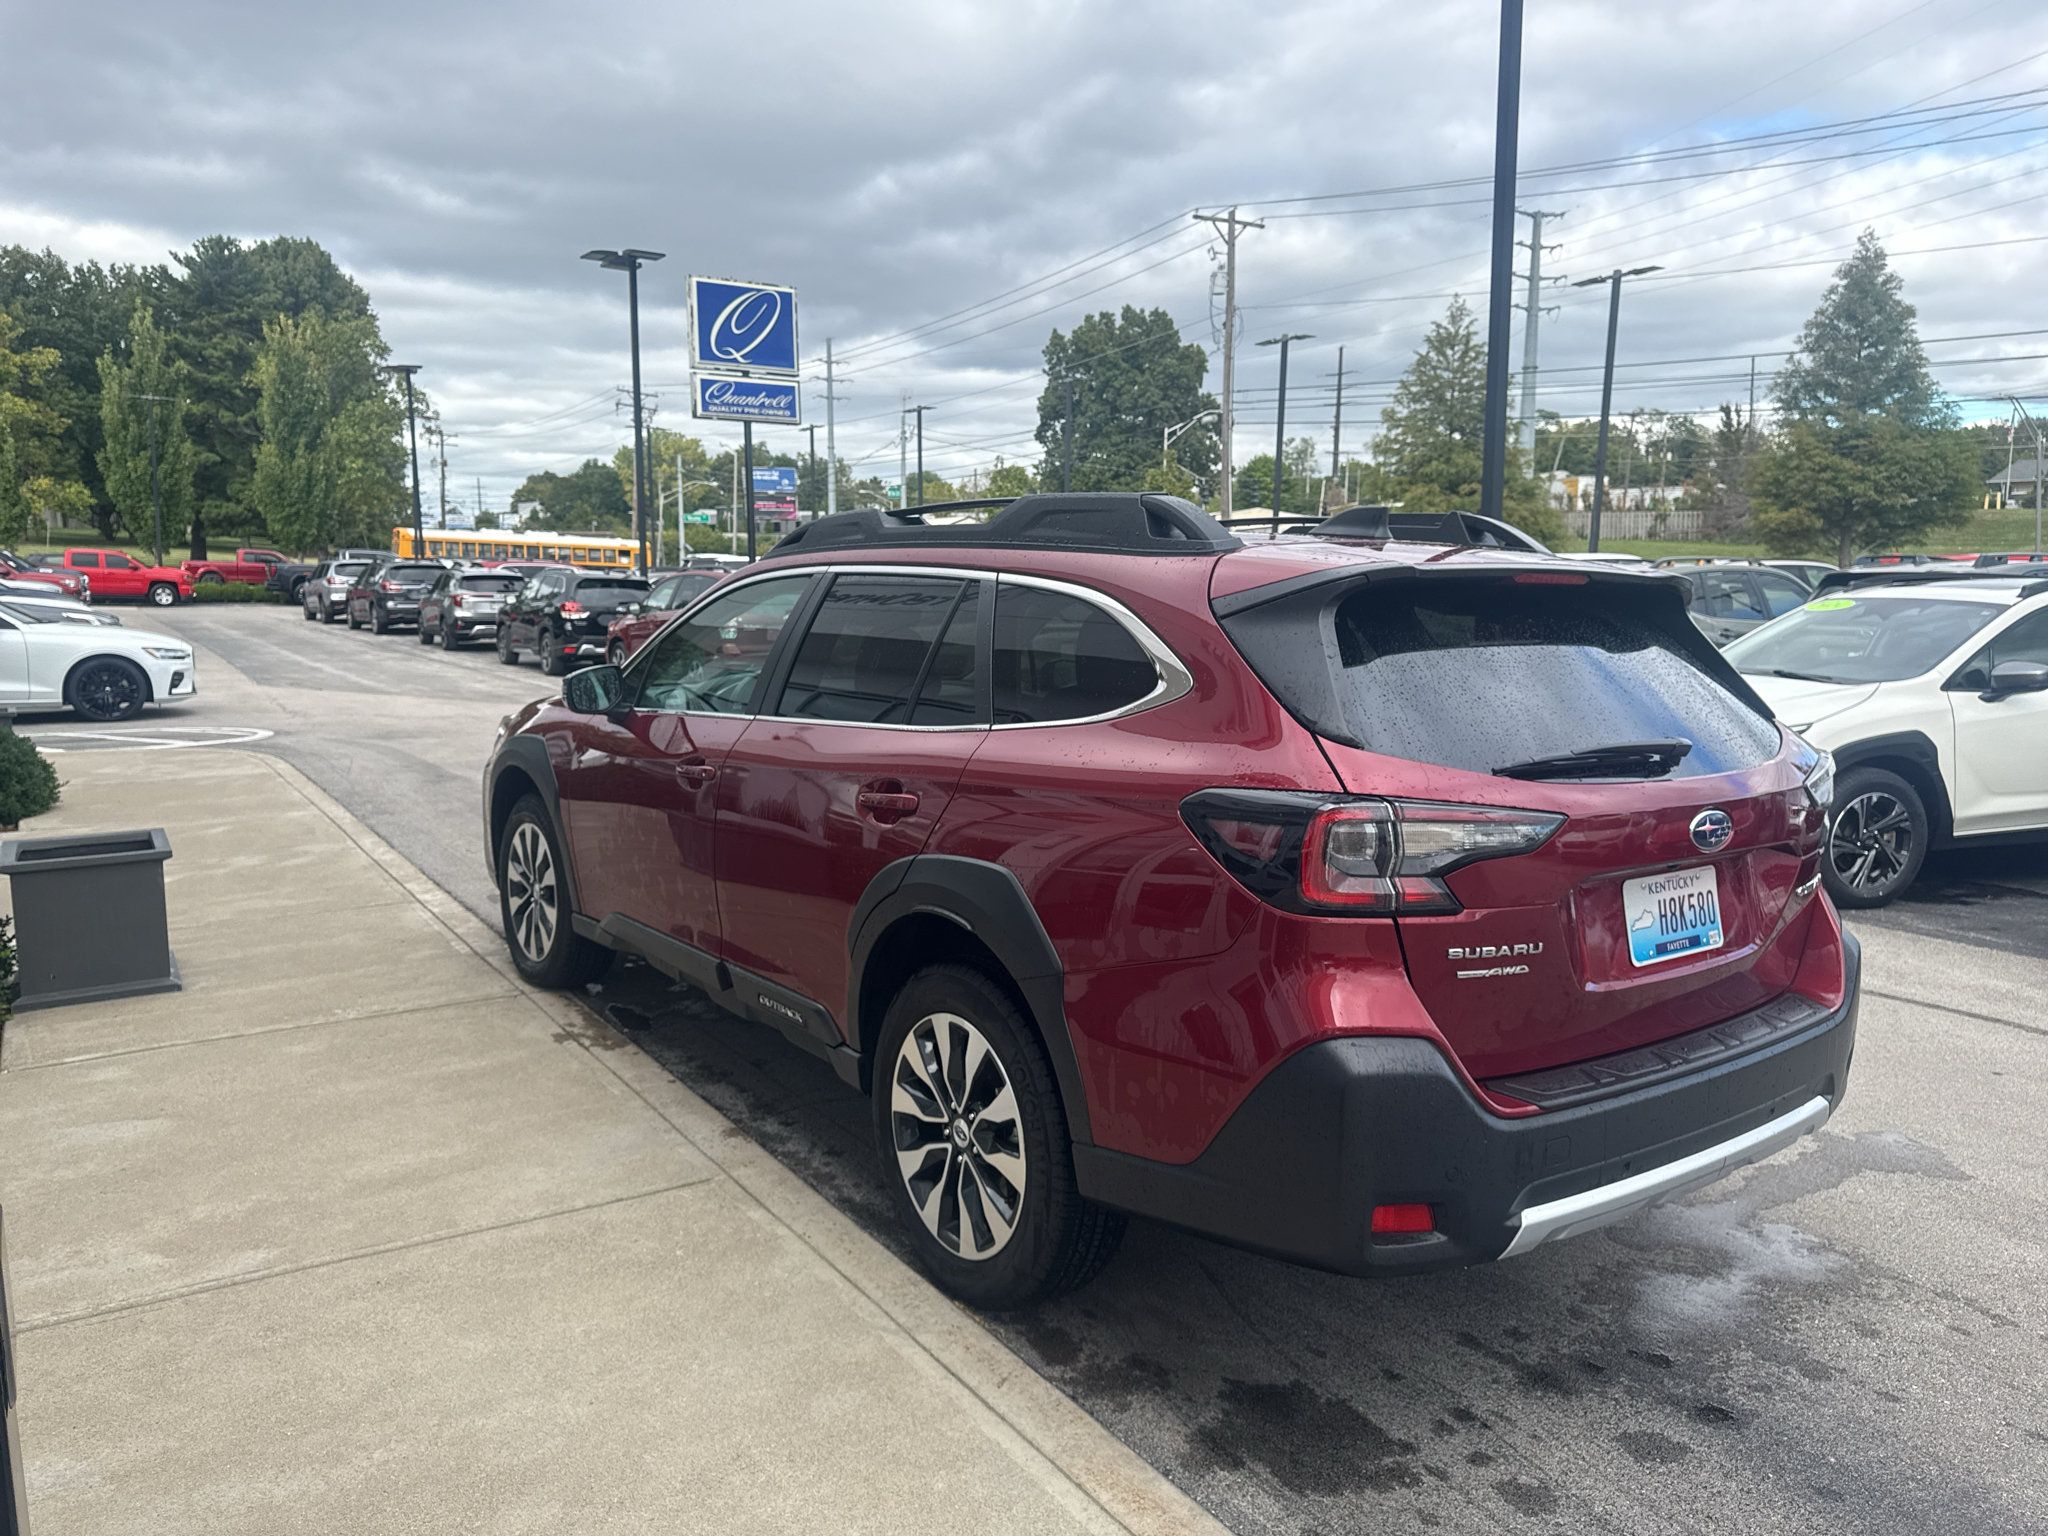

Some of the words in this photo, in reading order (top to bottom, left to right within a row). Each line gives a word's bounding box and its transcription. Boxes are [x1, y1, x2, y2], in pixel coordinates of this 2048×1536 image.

[711, 290, 781, 363] Q
[705, 381, 792, 408] Quantrell
[708, 405, 743, 414] QUALITY
[743, 407, 791, 417] PRE-OWNED
[1648, 876, 1696, 895] KENTUCKY
[1658, 890, 1717, 936] H8K580
[1447, 942, 1543, 960] SUBARU
[1667, 939, 1690, 951] FAYETTE
[1484, 965, 1530, 977] AWD
[759, 995, 803, 1023] OUTBACK
